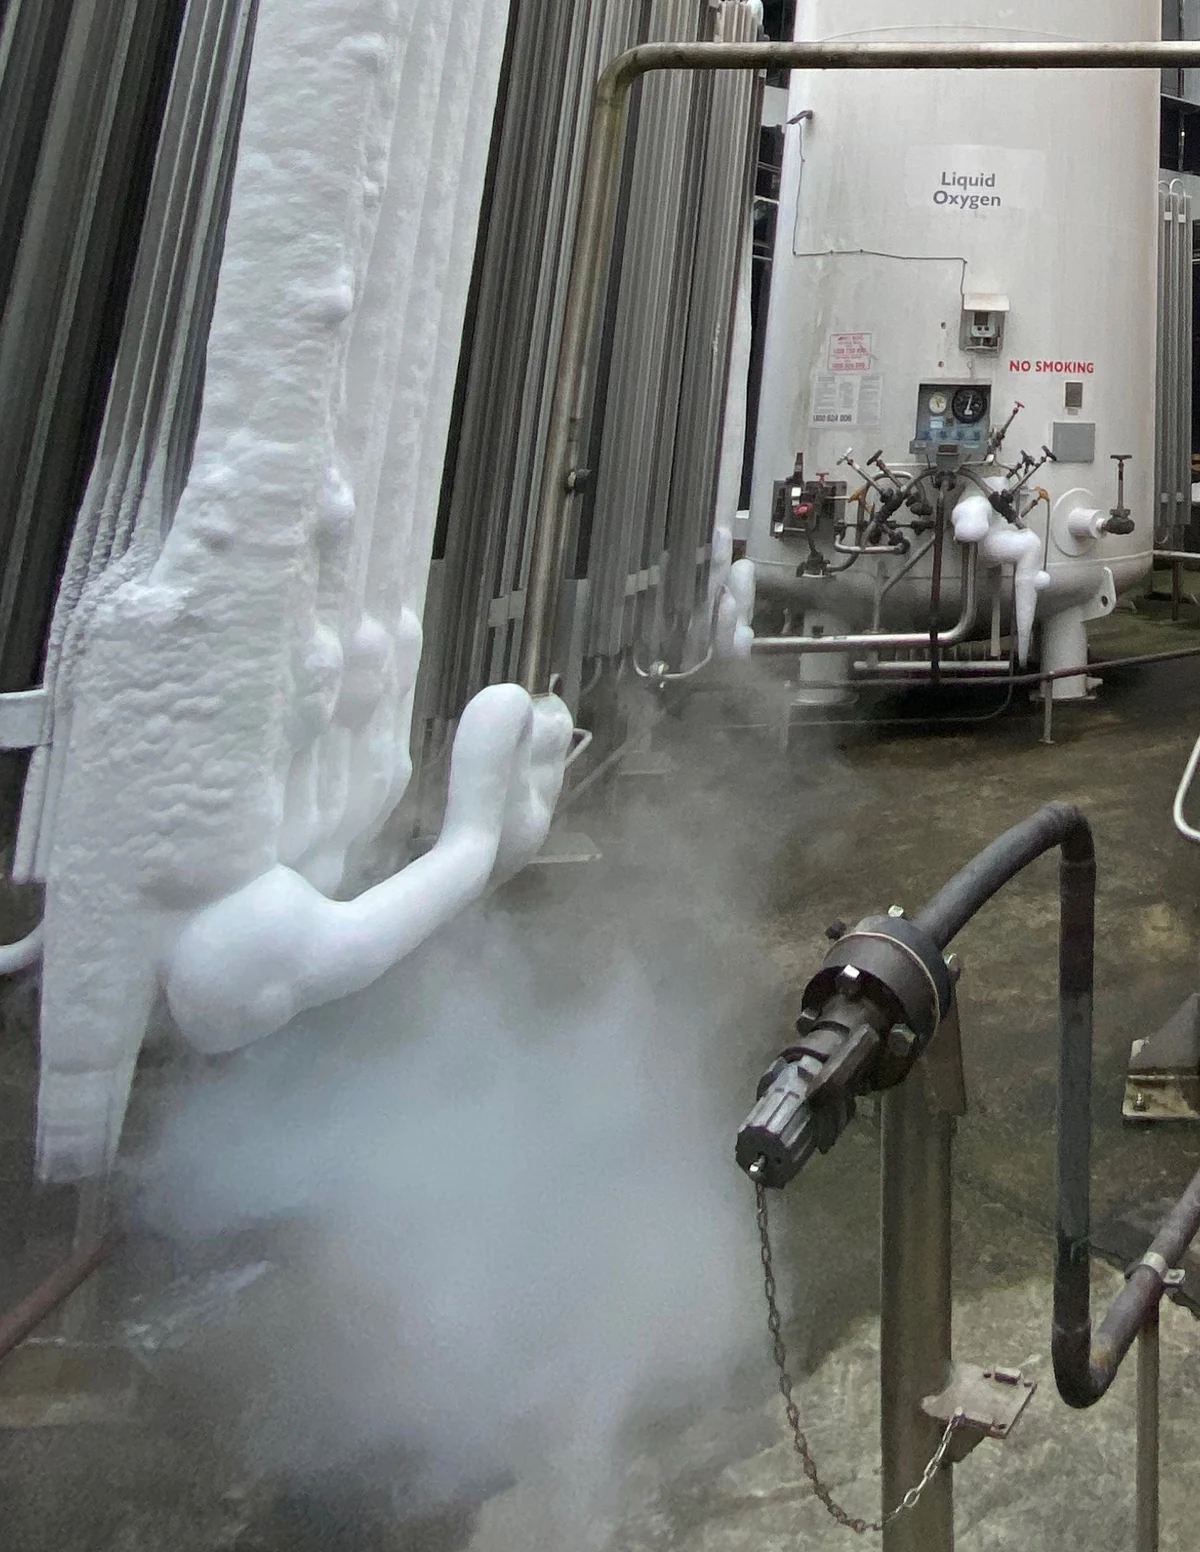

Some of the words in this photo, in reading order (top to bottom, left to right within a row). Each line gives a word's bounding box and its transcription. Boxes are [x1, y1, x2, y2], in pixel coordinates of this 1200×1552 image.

[940, 171, 996, 191] Liquid
[932, 189, 1002, 209] Oxygen
[1008, 360, 1032, 372] NO
[1036, 360, 1094, 374] SMOKING
